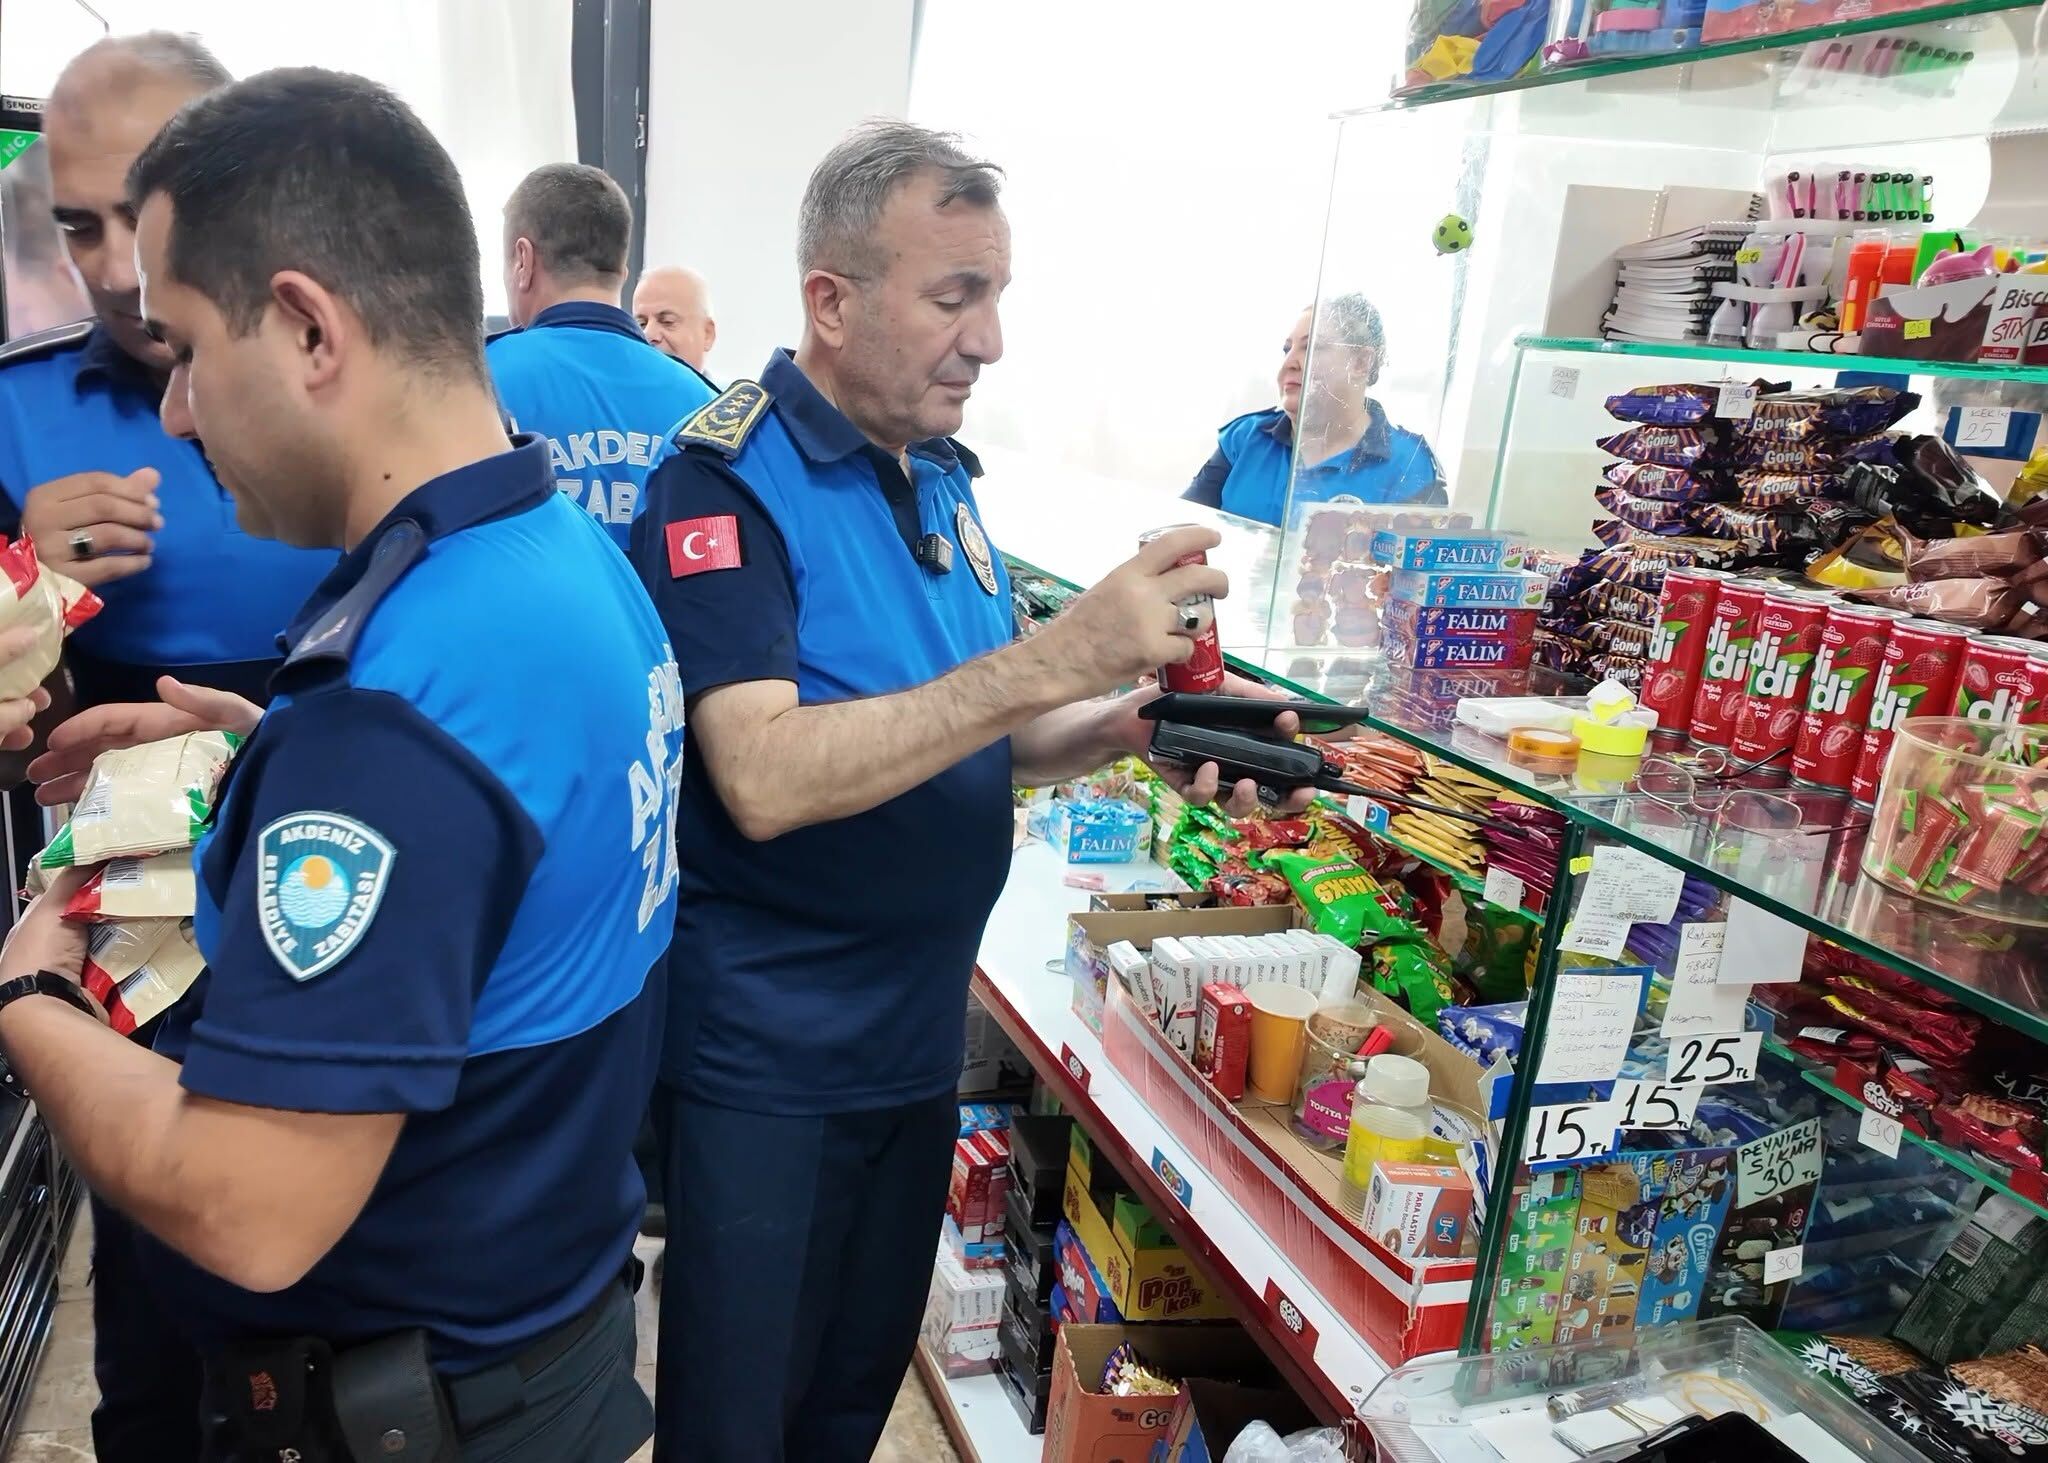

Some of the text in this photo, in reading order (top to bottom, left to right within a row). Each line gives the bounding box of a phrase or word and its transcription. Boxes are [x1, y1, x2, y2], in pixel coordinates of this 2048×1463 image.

[1961, 422, 2001, 442] 25
[1765, 449, 1805, 464] Gong
[1638, 468, 1666, 483] Gong
[1760, 479, 1799, 496] Gong
[1436, 547, 1497, 564] FALIM
[1631, 557, 1669, 573] Gong
[1458, 584, 1517, 601] FALIM
[1447, 613, 1508, 631] FALIM
[1446, 645, 1506, 662] FALIM
[1611, 637, 1642, 655] Gong
[1750, 631, 1781, 670] di
[1709, 644, 1750, 682] di
[1756, 660, 1801, 698] di
[1811, 674, 1853, 715] di
[280, 824, 368, 856] AKDENİZ
[1081, 838, 1132, 851] FALIM
[1670, 1037, 1741, 1084] 25
[1619, 1084, 1685, 1129] 15
[1528, 1106, 1609, 1162] 15 TL
[1864, 1117, 1897, 1146] 30
[1754, 1160, 1819, 1196] 30 TL
[1769, 1252, 1800, 1273] 30
